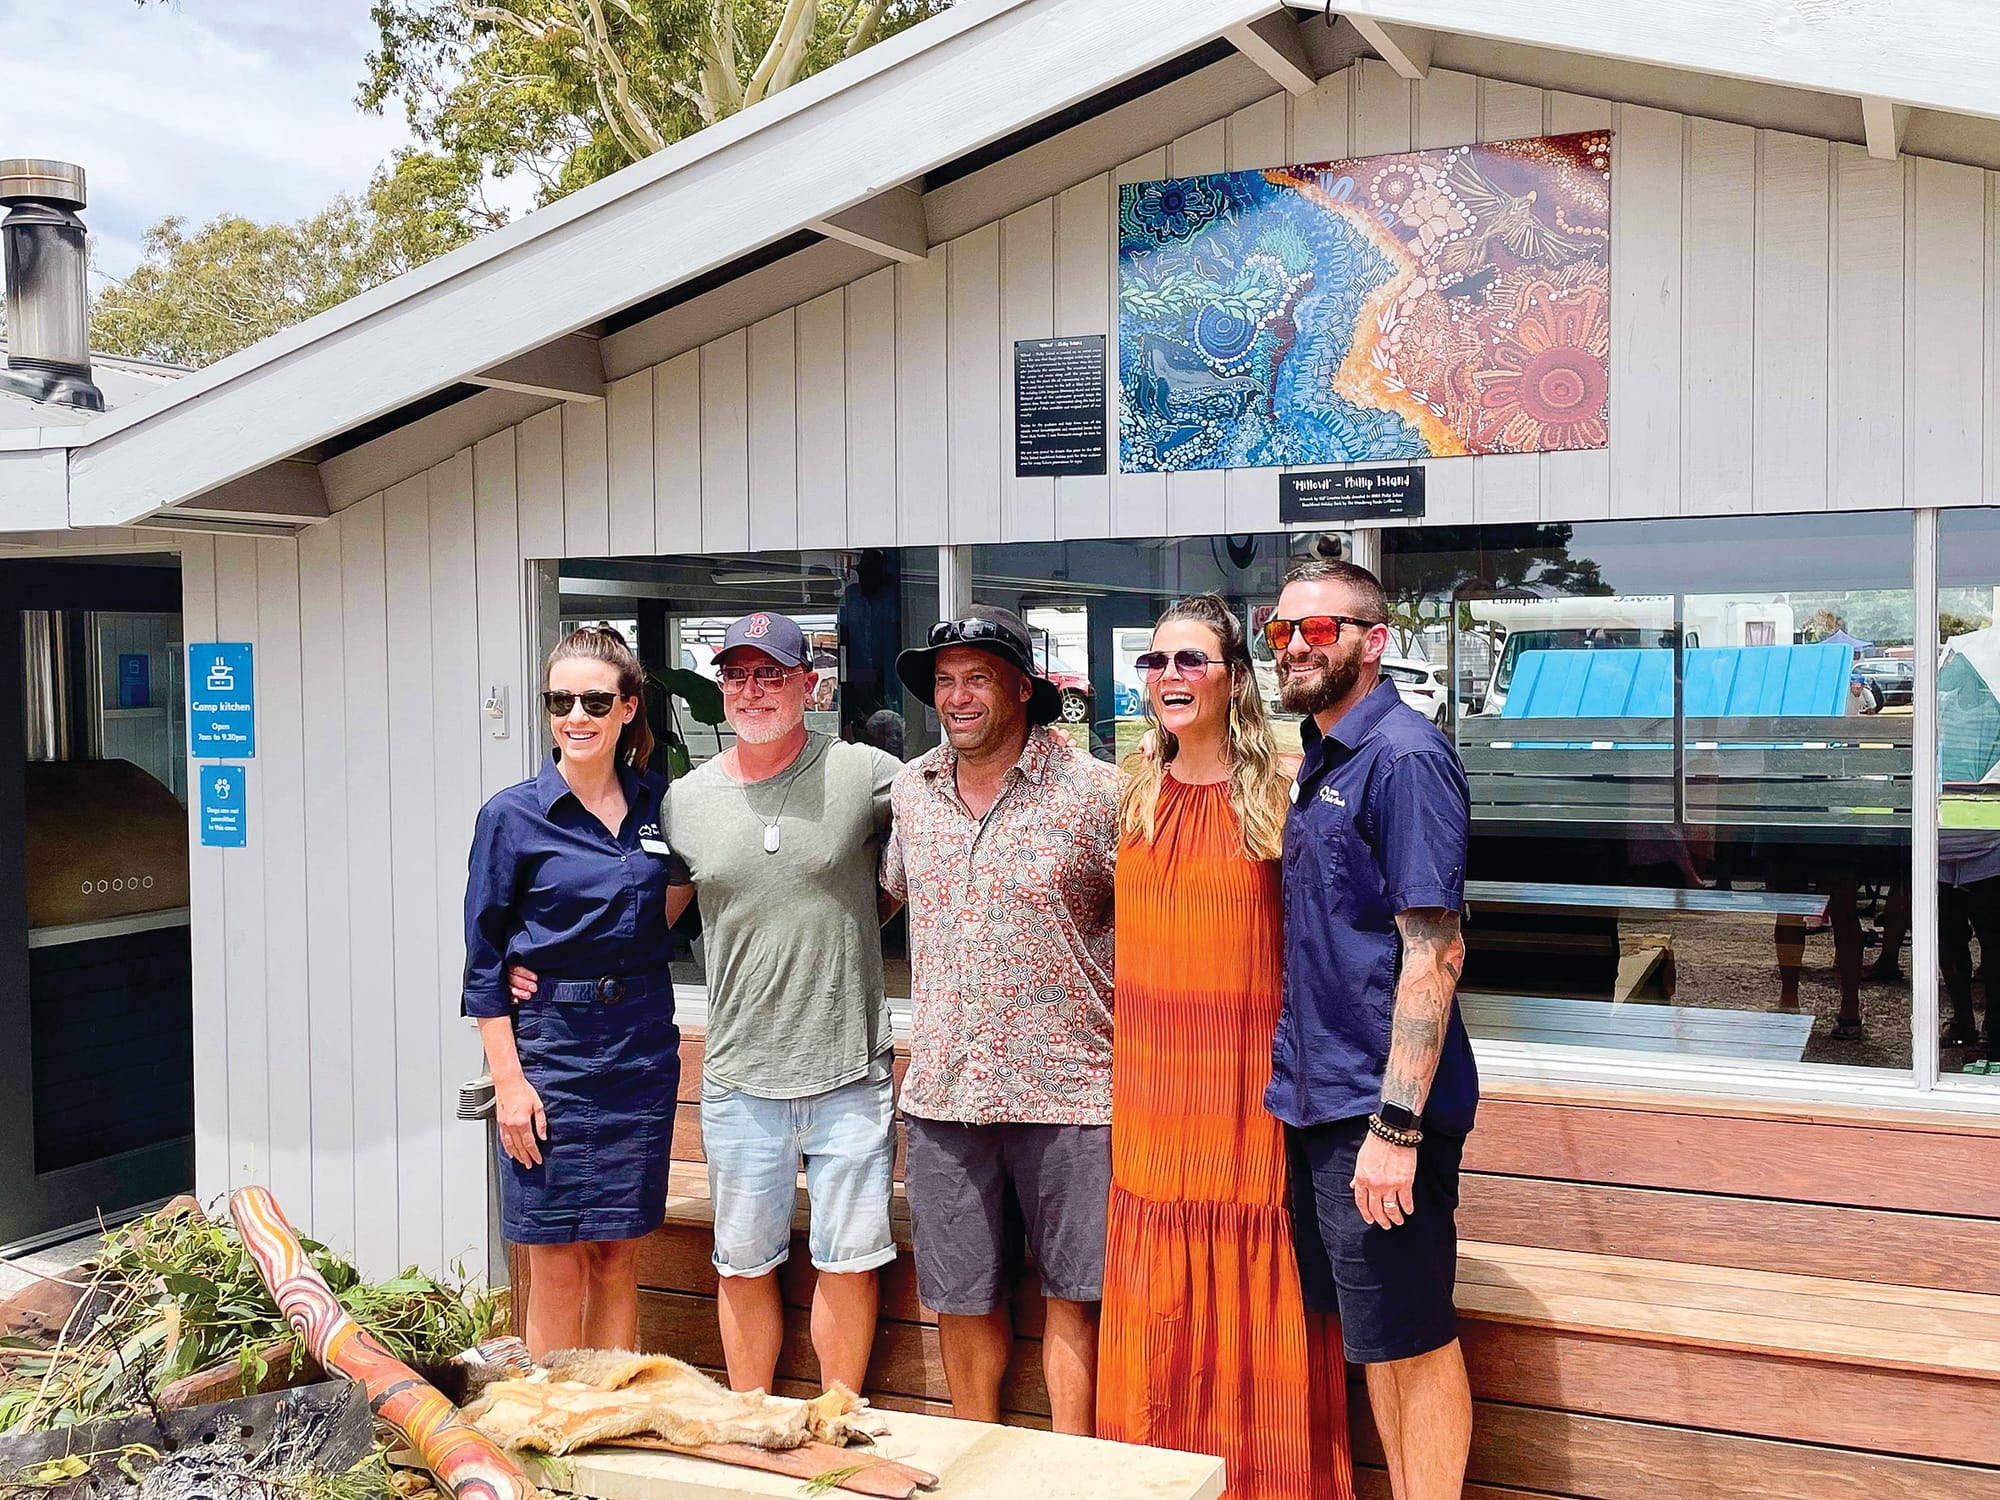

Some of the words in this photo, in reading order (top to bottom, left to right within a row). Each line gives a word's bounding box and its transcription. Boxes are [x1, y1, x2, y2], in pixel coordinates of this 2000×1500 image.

[1344, 476, 1374, 491] Phillip
[1376, 474, 1411, 488] Island
[744, 612, 772, 639] B
[192, 701, 218, 714] Camp
[219, 701, 251, 712] kitchen
[211, 722, 231, 732] Open
